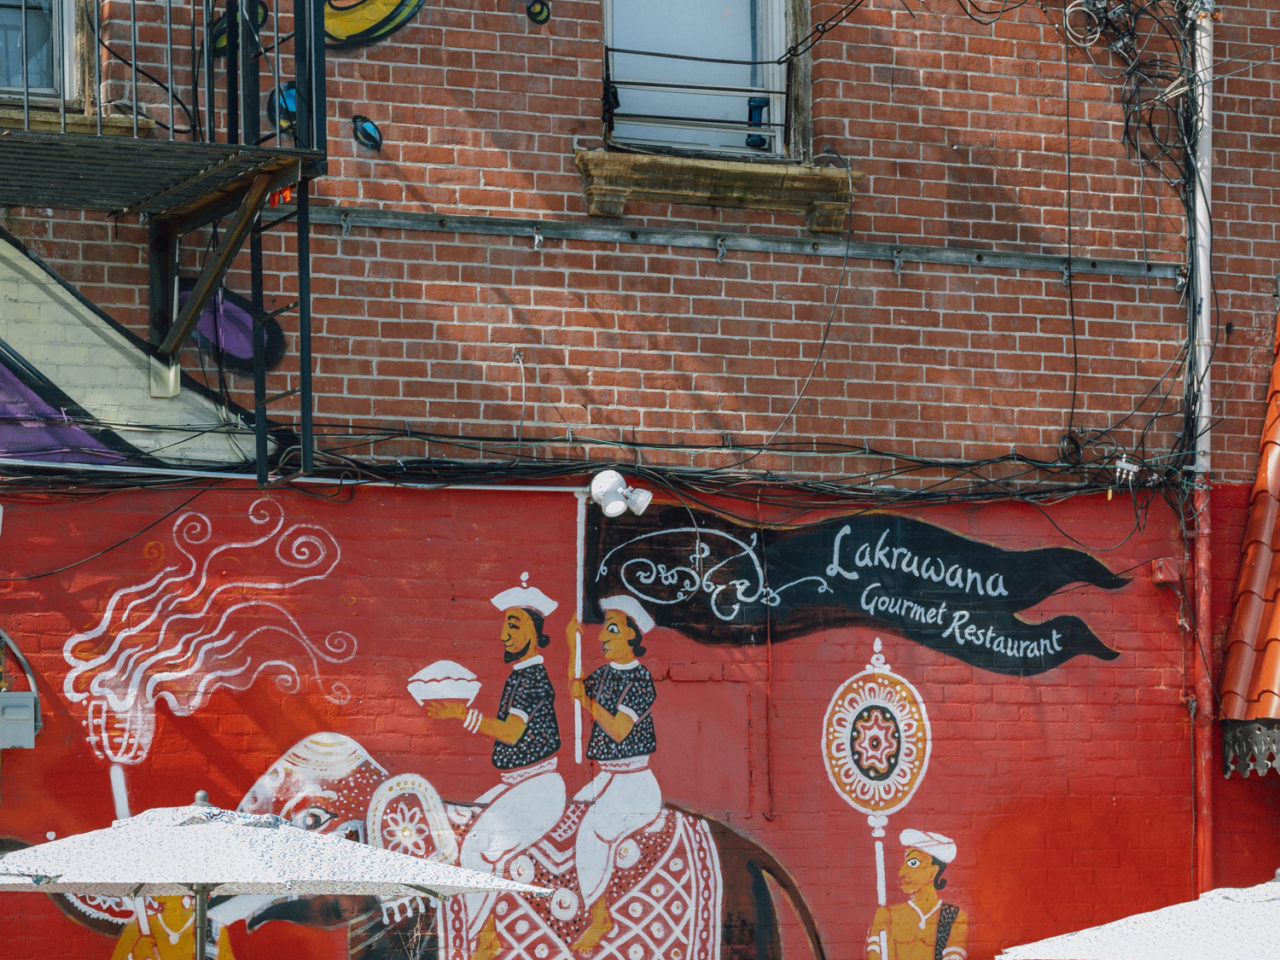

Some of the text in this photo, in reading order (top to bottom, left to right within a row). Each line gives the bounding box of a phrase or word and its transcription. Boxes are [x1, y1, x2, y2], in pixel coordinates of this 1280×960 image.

[825, 524, 1009, 597] Lakruwana
[860, 582, 1064, 658] Gourmet Restaurant
